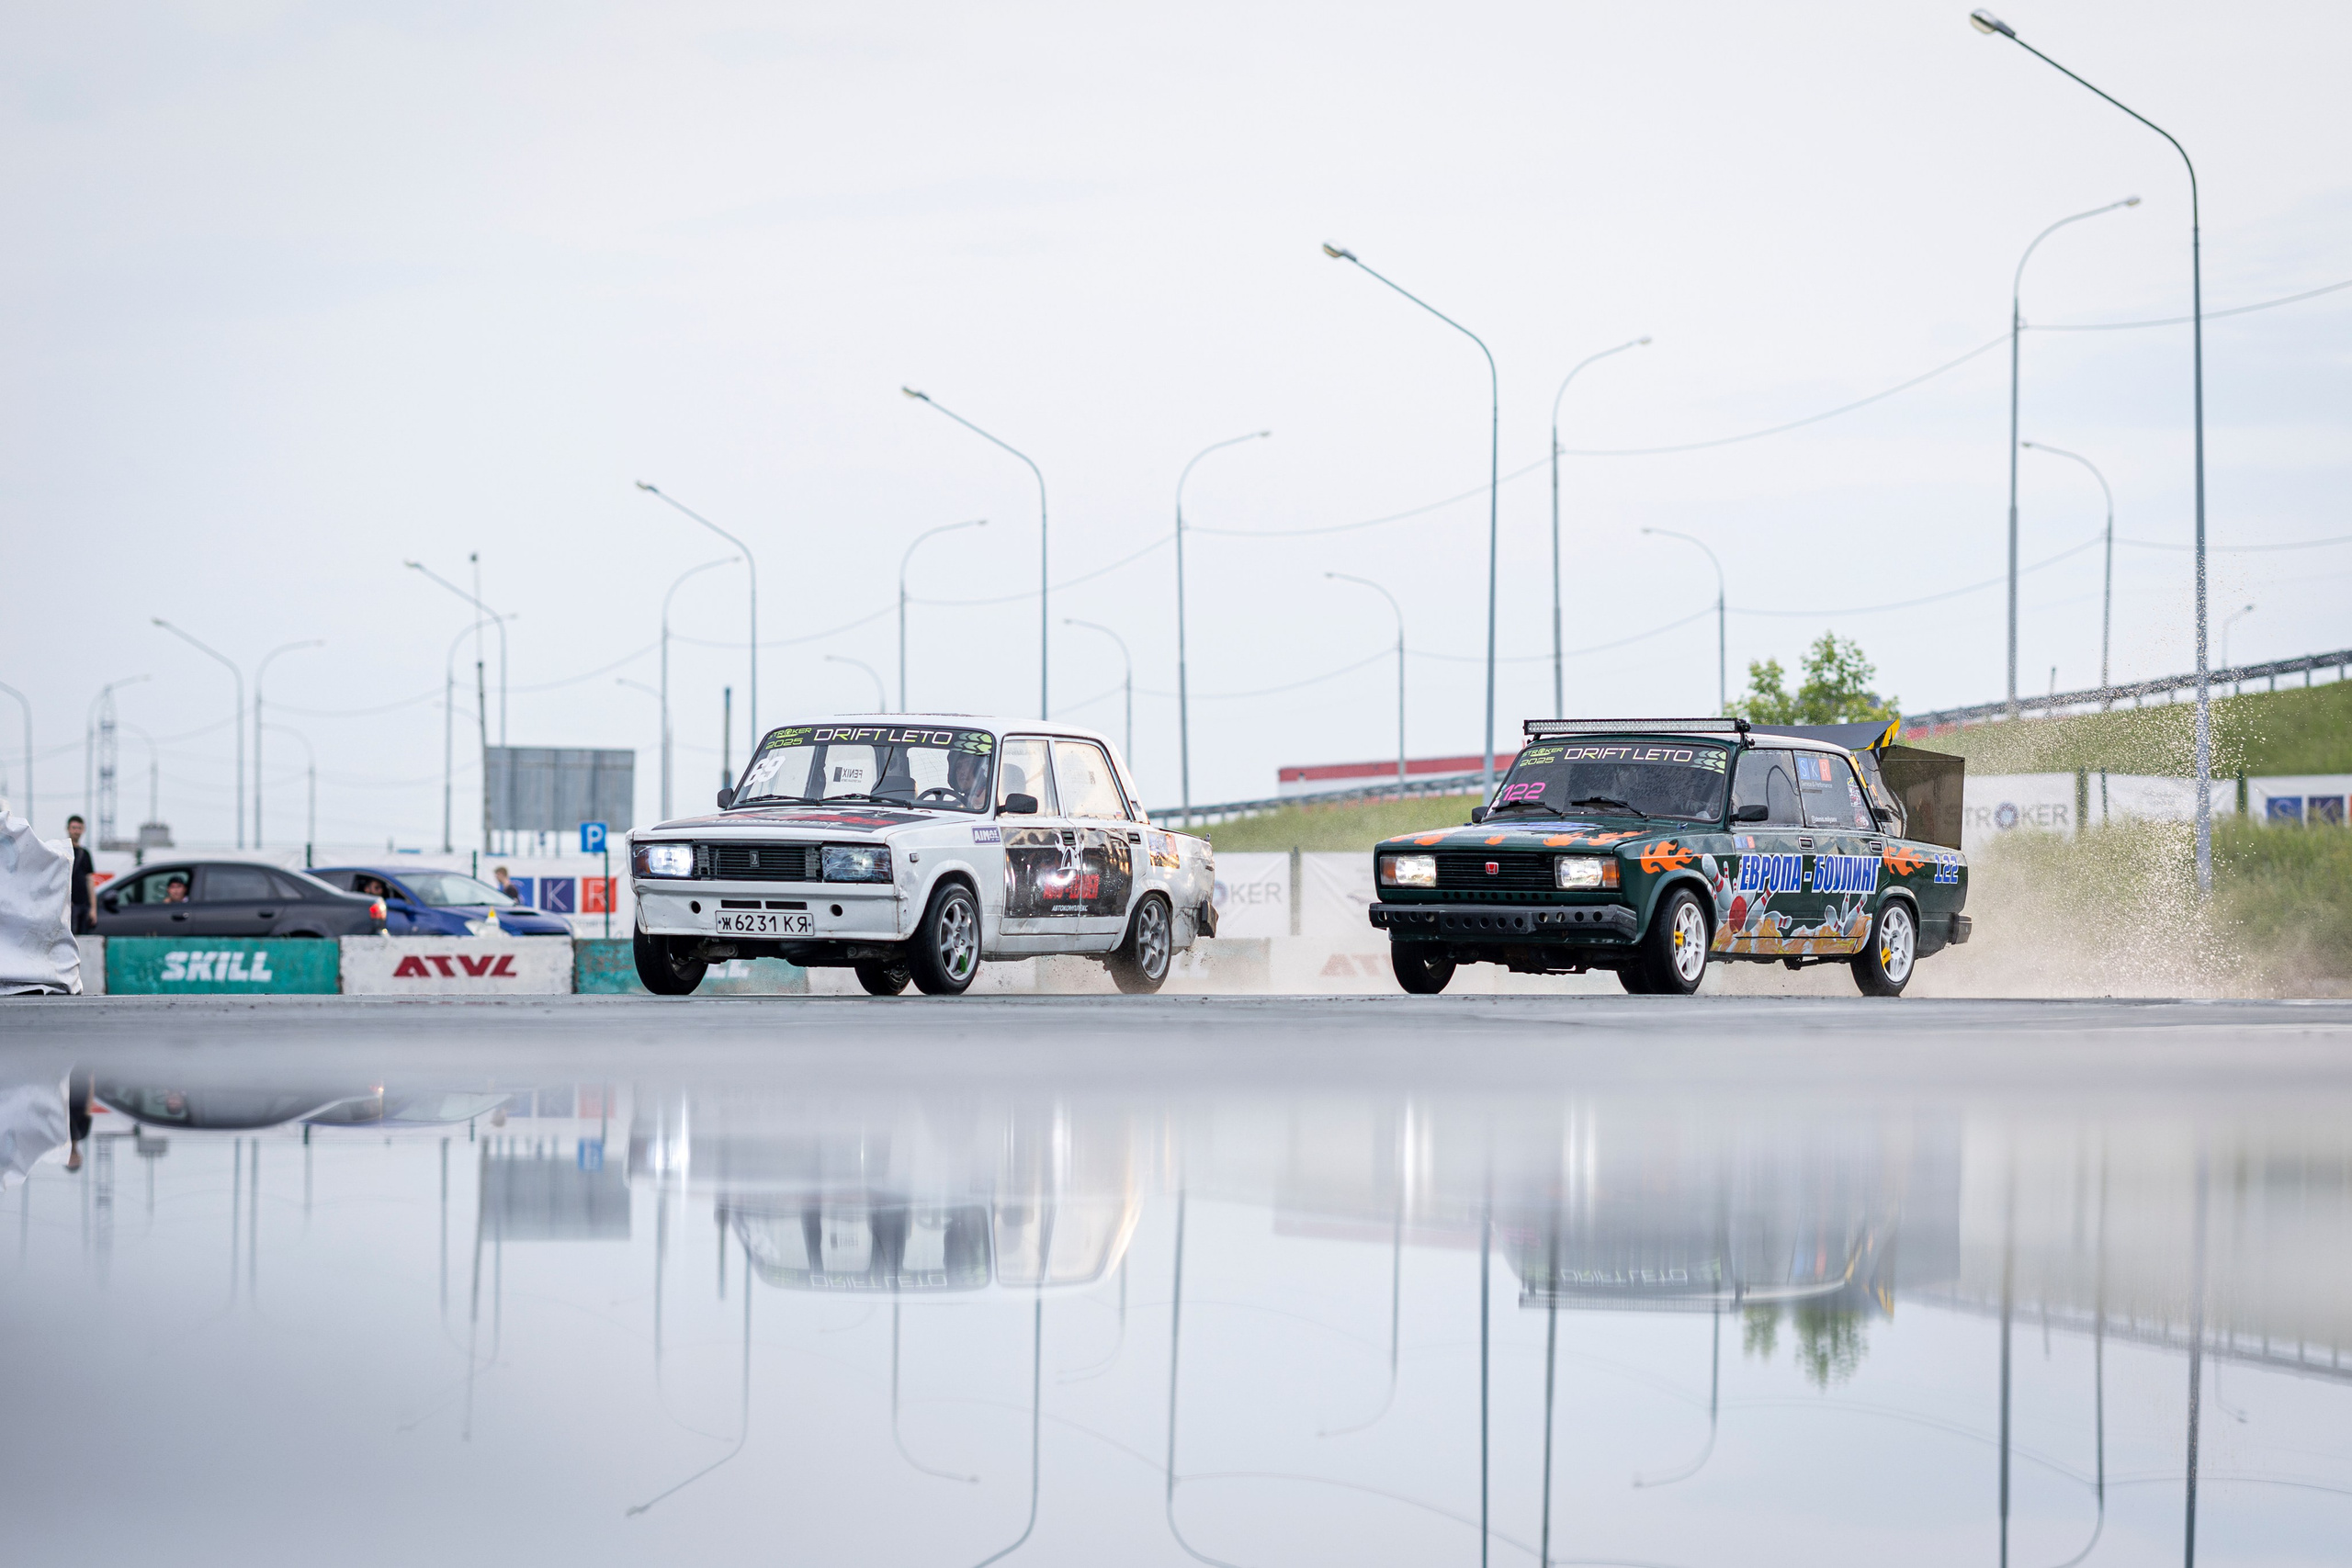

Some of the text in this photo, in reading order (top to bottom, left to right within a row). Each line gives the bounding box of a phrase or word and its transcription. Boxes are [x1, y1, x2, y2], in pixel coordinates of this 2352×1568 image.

[765, 738, 803, 750] 2025
[814, 728, 953, 745] DRIFT LETO
[1520, 756, 1555, 767] 2025
[1564, 748, 1692, 762] DRIFT LETO
[1800, 760, 1829, 779] SKR
[1503, 782, 1546, 802] 122
[1740, 854, 1803, 894] ЕВРОПА
[1812, 855, 1883, 895] БОУЛИНГ
[1934, 853, 1959, 884] 122
[161, 951, 272, 982] SKILL
